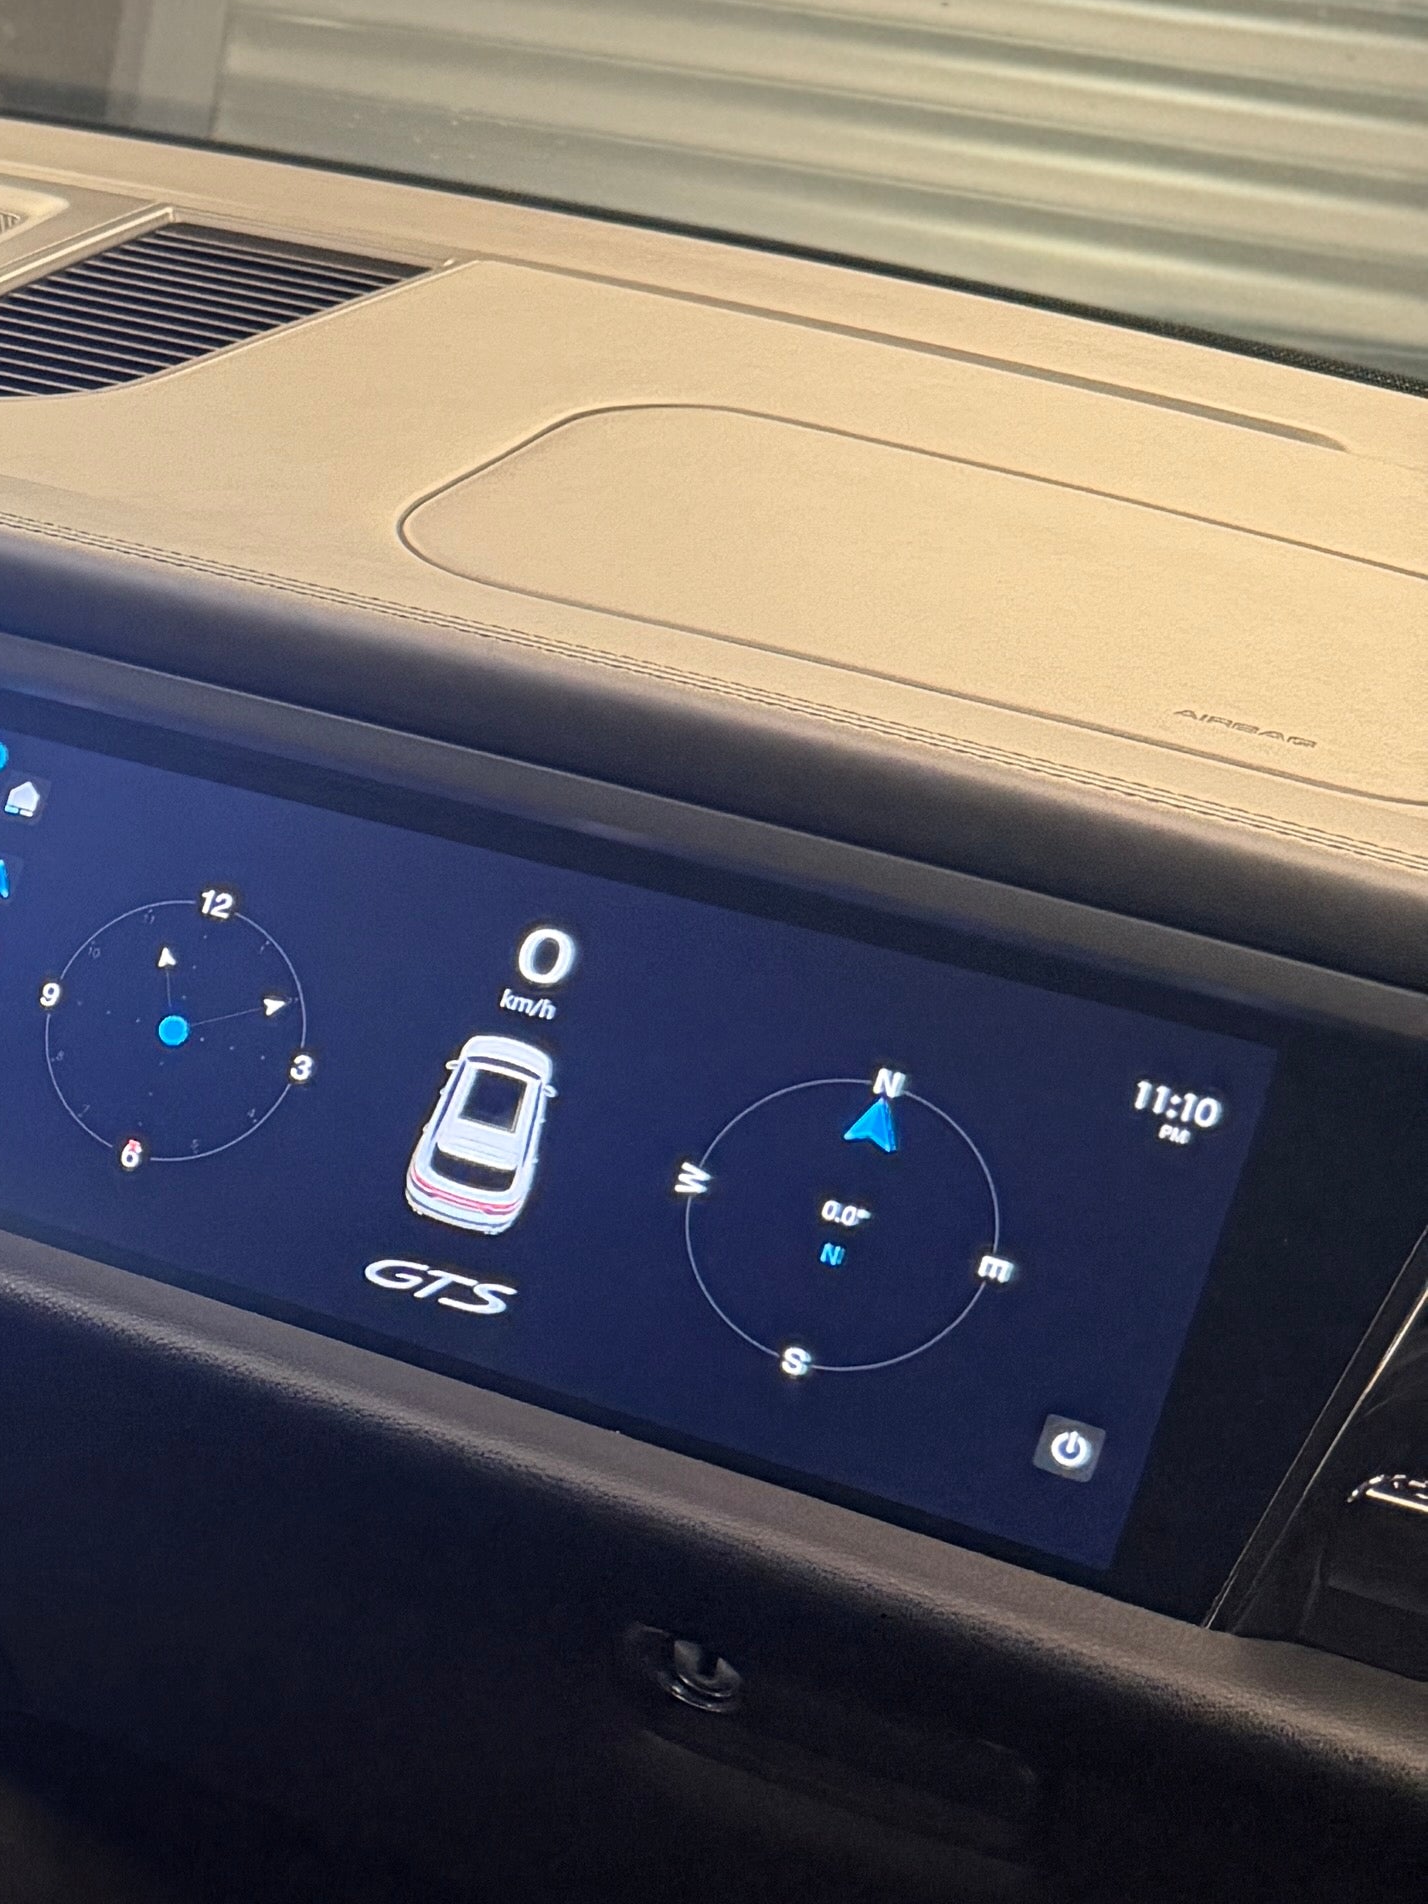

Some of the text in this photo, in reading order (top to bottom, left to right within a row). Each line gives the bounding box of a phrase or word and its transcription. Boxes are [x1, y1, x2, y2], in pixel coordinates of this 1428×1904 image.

[1173, 708, 1318, 749] AIRBAG
[200, 889, 234, 920] 12
[517, 928, 576, 985] 0
[39, 982, 62, 1008] 9
[499, 988, 557, 1021] km/h
[289, 1053, 314, 1082] 3
[872, 1067, 907, 1099] N
[1134, 1080, 1223, 1128] 11:10
[1158, 1123, 1192, 1145] PM
[120, 1139, 142, 1170] 6
[673, 1161, 712, 1195] W
[819, 1242, 845, 1266] N
[977, 1254, 1015, 1284] E
[364, 1258, 518, 1315] GTS
[780, 1346, 813, 1376] S
